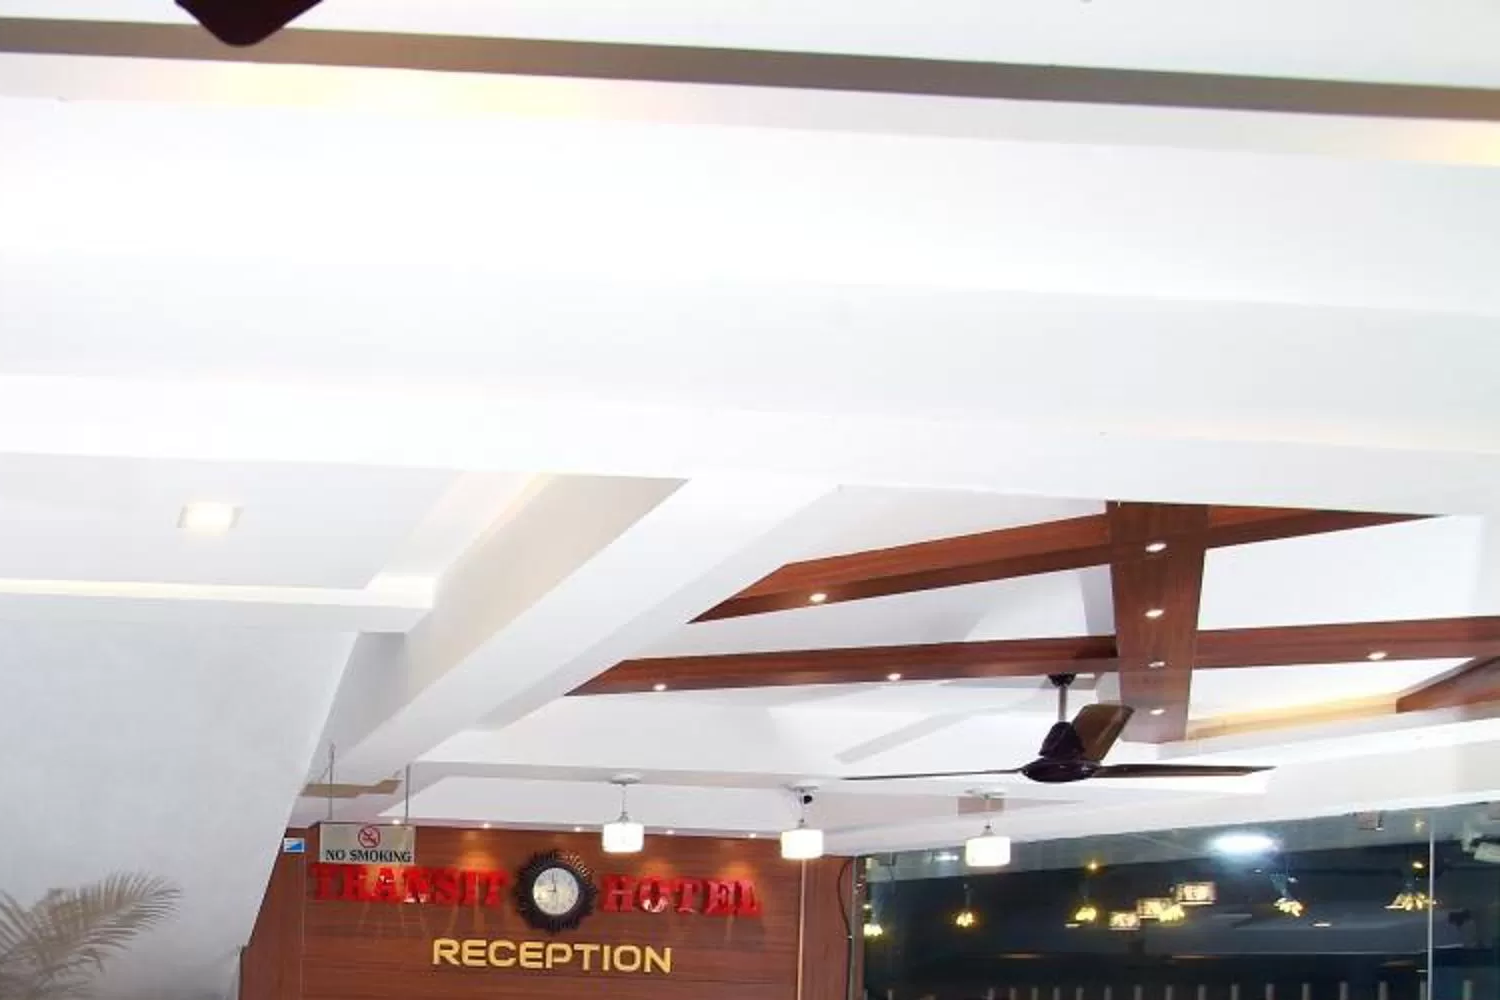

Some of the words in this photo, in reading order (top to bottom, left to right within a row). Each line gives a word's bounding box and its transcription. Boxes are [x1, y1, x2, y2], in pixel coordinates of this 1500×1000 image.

[325, 849, 345, 862] NO
[350, 850, 412, 864] SMOKING
[311, 863, 510, 906] TRANSIT
[602, 875, 762, 916] HOTEL
[432, 938, 673, 974] RECEPTION
